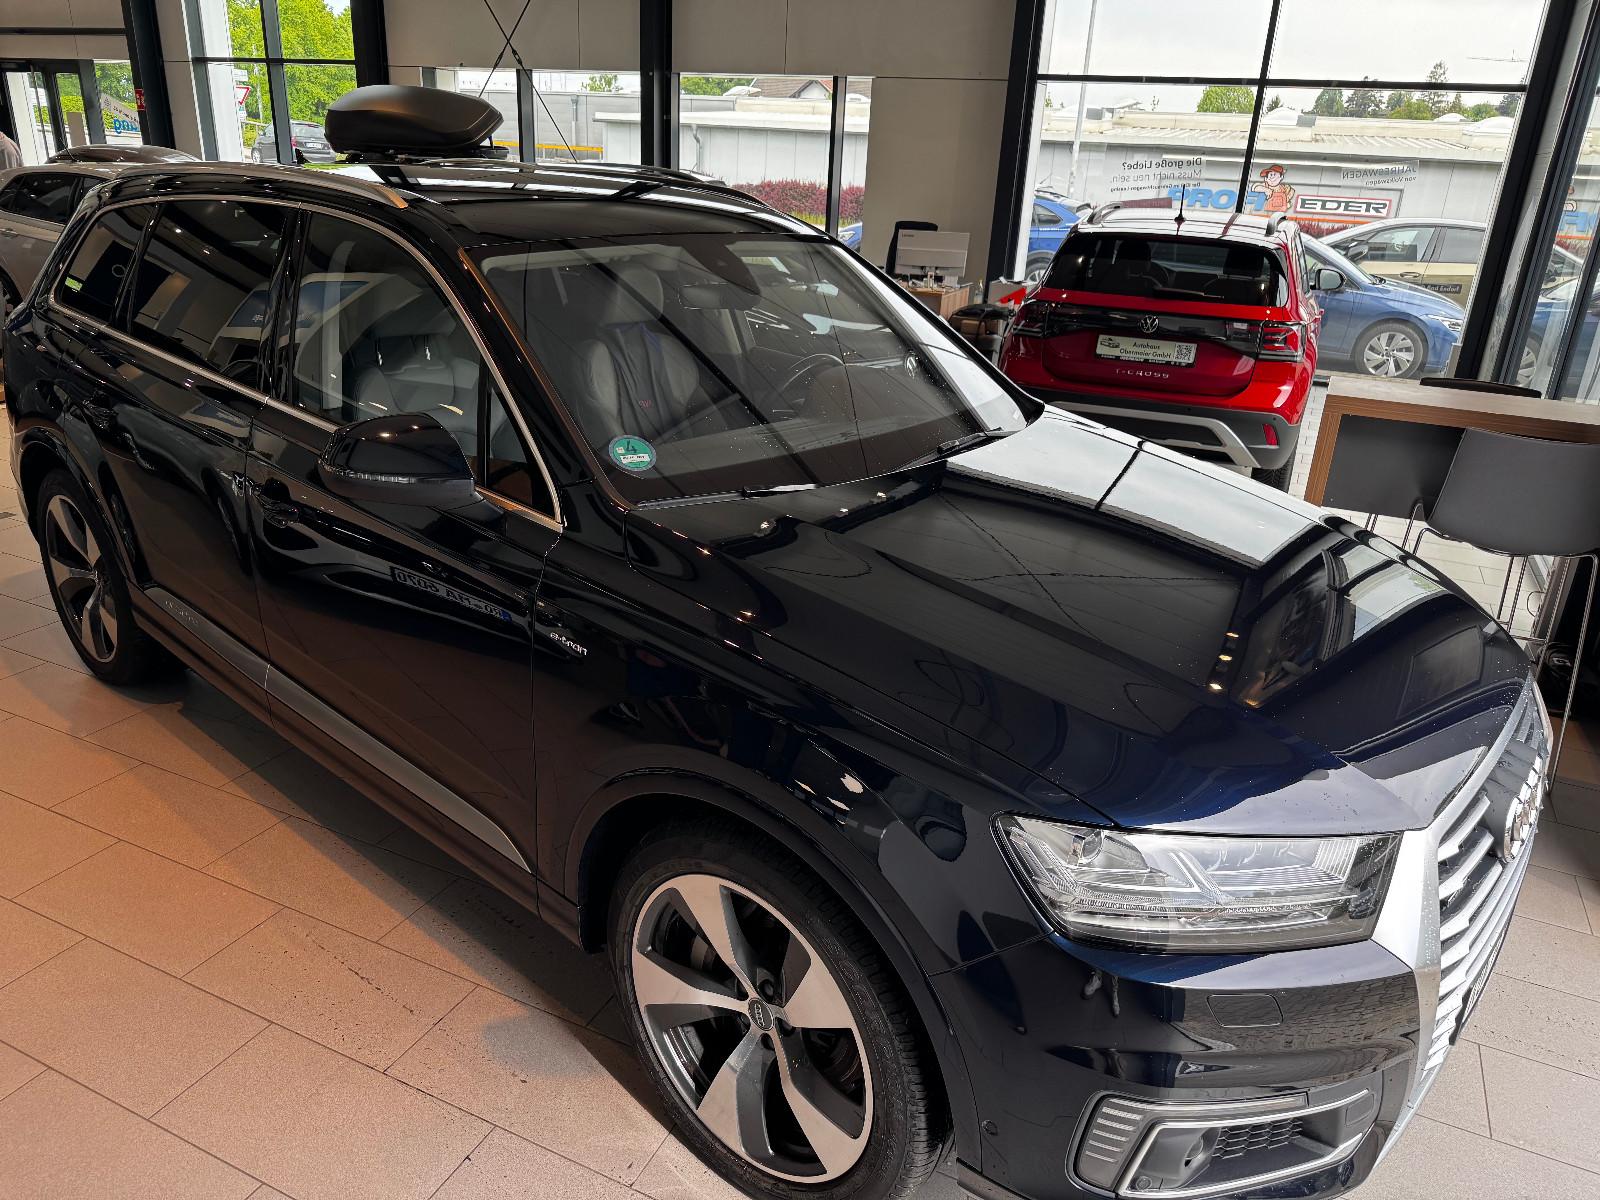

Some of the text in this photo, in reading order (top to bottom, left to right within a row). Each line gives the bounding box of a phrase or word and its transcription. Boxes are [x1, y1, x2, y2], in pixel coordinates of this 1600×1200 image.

[1300, 197, 1388, 214] EDER
[1133, 342, 1160, 350] Autohaus
[1152, 351, 1172, 359] GmbH
[1116, 369, 1169, 379] T-CROSS
[626, 439, 637, 453] 4
[550, 631, 588, 656] e-tron
